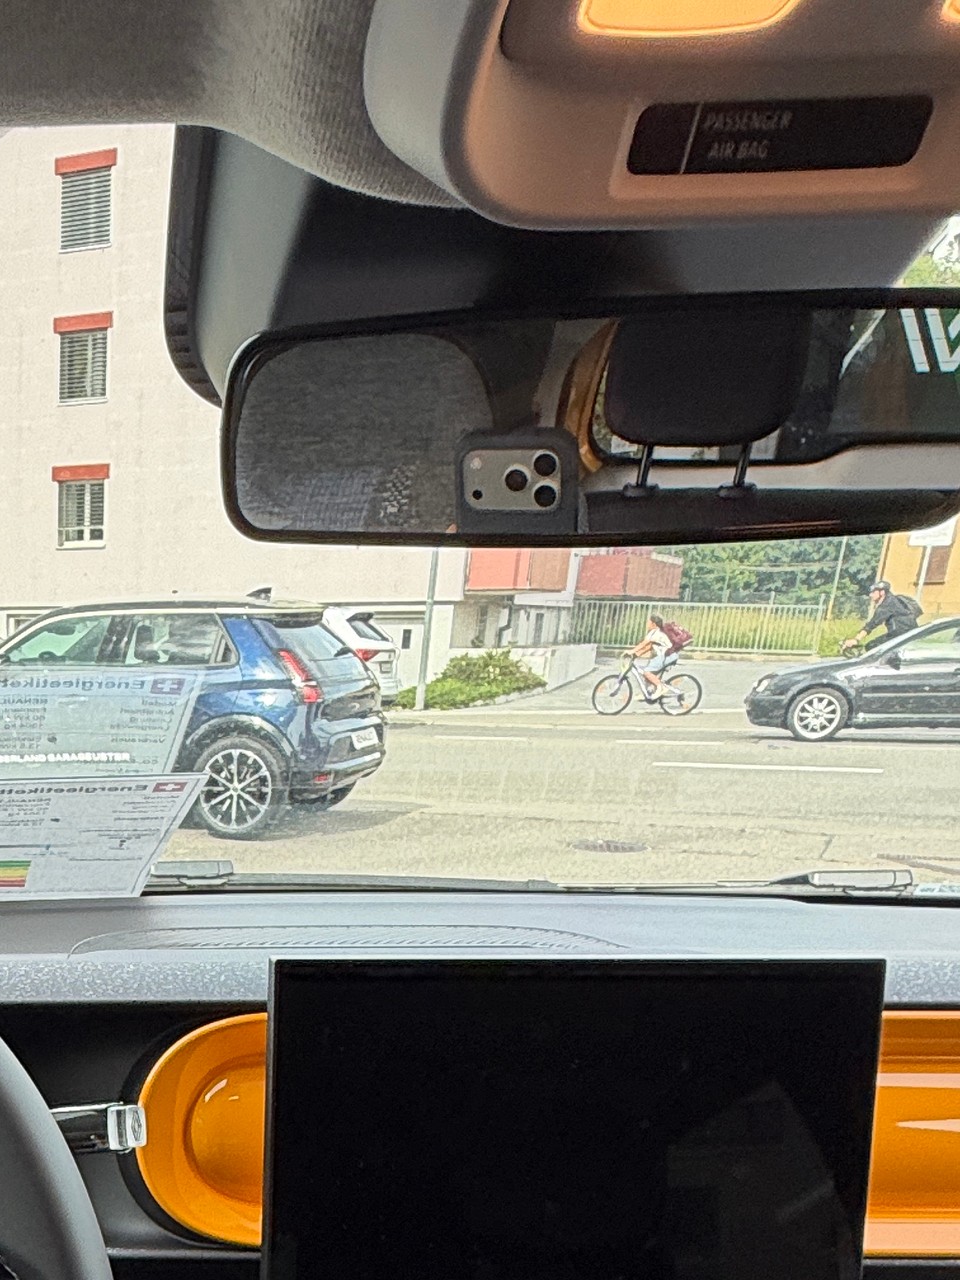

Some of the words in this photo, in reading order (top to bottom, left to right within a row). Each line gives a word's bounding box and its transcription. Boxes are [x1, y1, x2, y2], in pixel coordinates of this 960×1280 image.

[703, 111, 793, 131] PASSENGER
[707, 140, 735, 159] AIR
[736, 140, 768, 159] BAG
